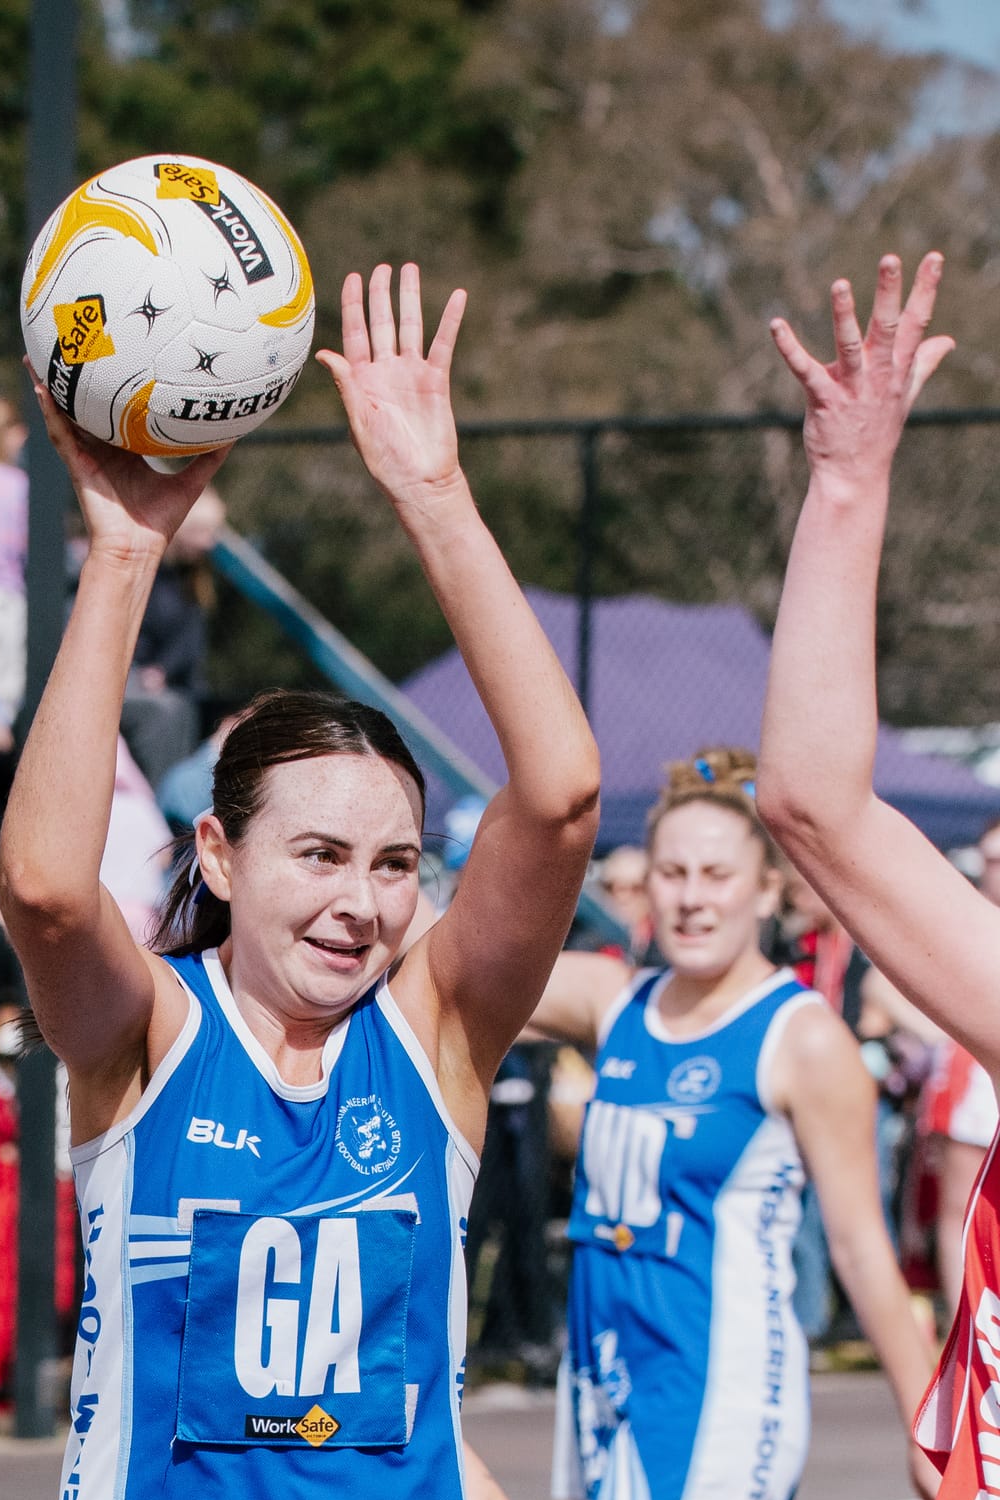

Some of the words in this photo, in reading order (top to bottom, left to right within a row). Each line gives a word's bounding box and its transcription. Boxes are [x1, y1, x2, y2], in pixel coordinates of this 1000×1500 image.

[186, 1116, 262, 1159] BLK
[336, 1141, 370, 1175] FOOTBALL
[391, 1130, 401, 1154] CLUB
[234, 1216, 363, 1399] GA
